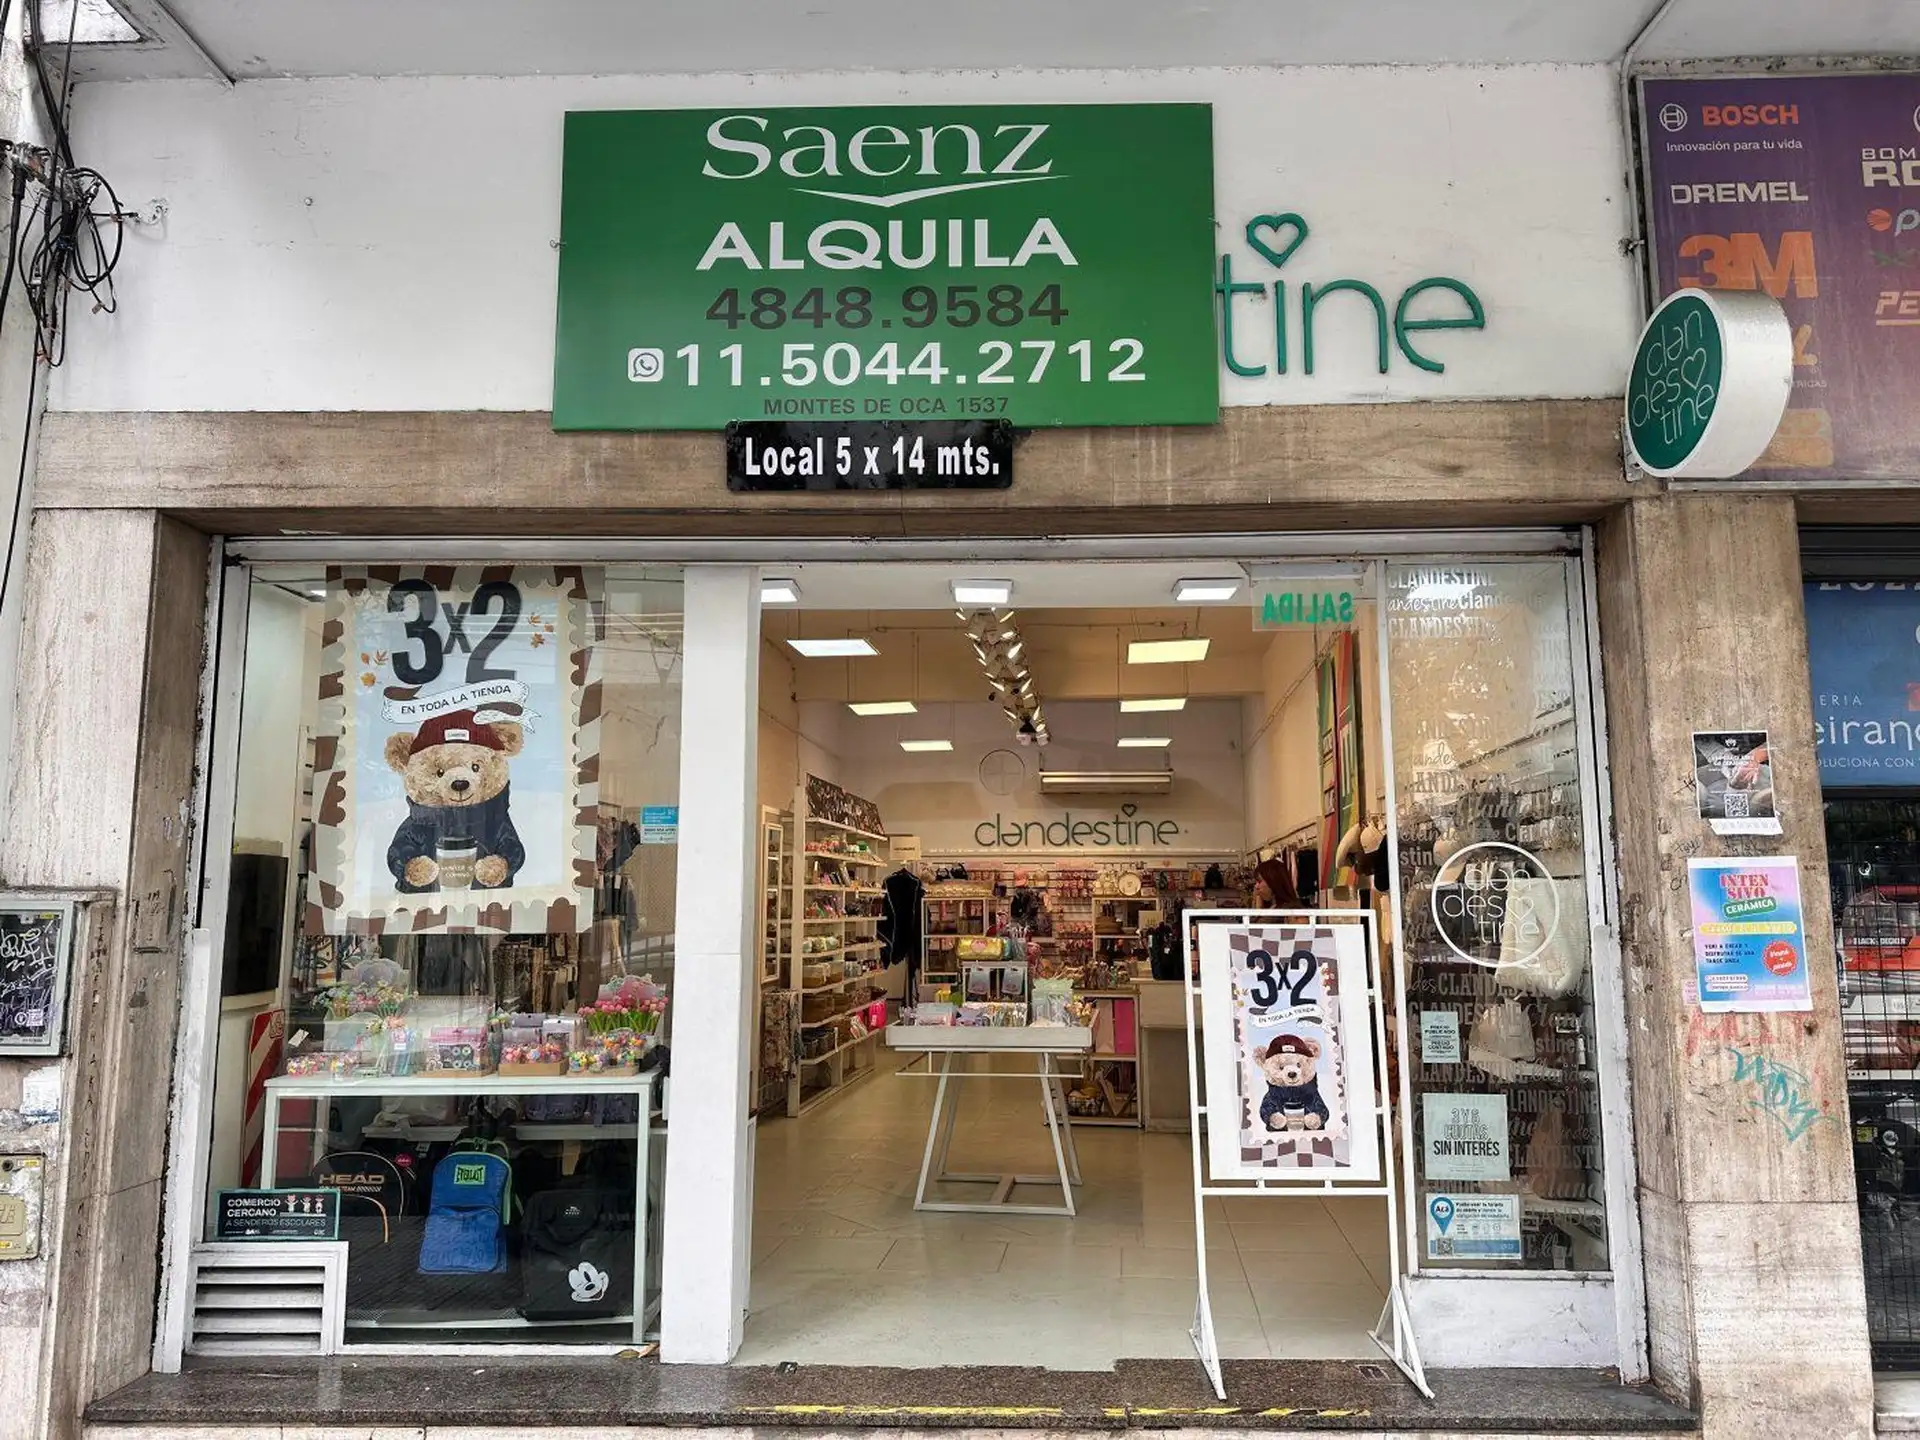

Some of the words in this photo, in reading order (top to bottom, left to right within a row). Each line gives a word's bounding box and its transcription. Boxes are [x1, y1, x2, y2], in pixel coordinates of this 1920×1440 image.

[1702, 104, 1799, 126] BOSCH
[701, 114, 1053, 180] Saenz
[1666, 140, 1731, 152] Innovación
[1733, 141, 1761, 152] para
[1762, 140, 1775, 150] tu
[1777, 138, 1803, 149] vida
[1862, 147, 1916, 160] BOM
[1670, 181, 1809, 204] DREMEL
[695, 217, 1079, 270] ALQUILA
[1678, 231, 1820, 298] 3M
[704, 283, 1070, 330] 4848.9584
[1216, 214, 1486, 377] tine
[1646, 310, 1703, 377] clan
[675, 338, 1147, 386] 11.5044.2712
[763, 398, 856, 415] MONTES
[863, 398, 892, 413] DE
[899, 397, 947, 414] OCA
[956, 397, 1009, 413] 1537
[1632, 367, 1681, 428] des
[1660, 384, 1715, 445] tine
[745, 437, 824, 476] Local
[836, 437, 851, 476] 5
[863, 446, 880, 475] x
[892, 436, 925, 476] 14
[937, 437, 1000, 476] mts.
[386, 578, 523, 685] 3x2
[401, 705, 416, 714] EN
[420, 699, 449, 713] TODA
[452, 693, 468, 702] LA
[470, 685, 511, 699] TIENDA
[1819, 694, 1862, 706] ERIA
[1885, 758, 1914, 768] CON
[974, 803, 1179, 847] clandestine
[1721, 873, 1768, 887] INTEN
[1727, 886, 1766, 899] SIVO
[1443, 884, 1504, 918] des
[1726, 899, 1774, 914] CERÁMICA
[1478, 915, 1540, 944] tine
[1246, 949, 1318, 1008] 3x2
[1433, 1140, 1452, 1156] SIN
[1454, 1137, 1500, 1157] INTERÉS
[319, 1174, 385, 1185] HEAD
[227, 1198, 281, 1207] COMERCIO
[227, 1208, 277, 1217] CERCANO
[233, 1219, 279, 1227] SENDEROS
